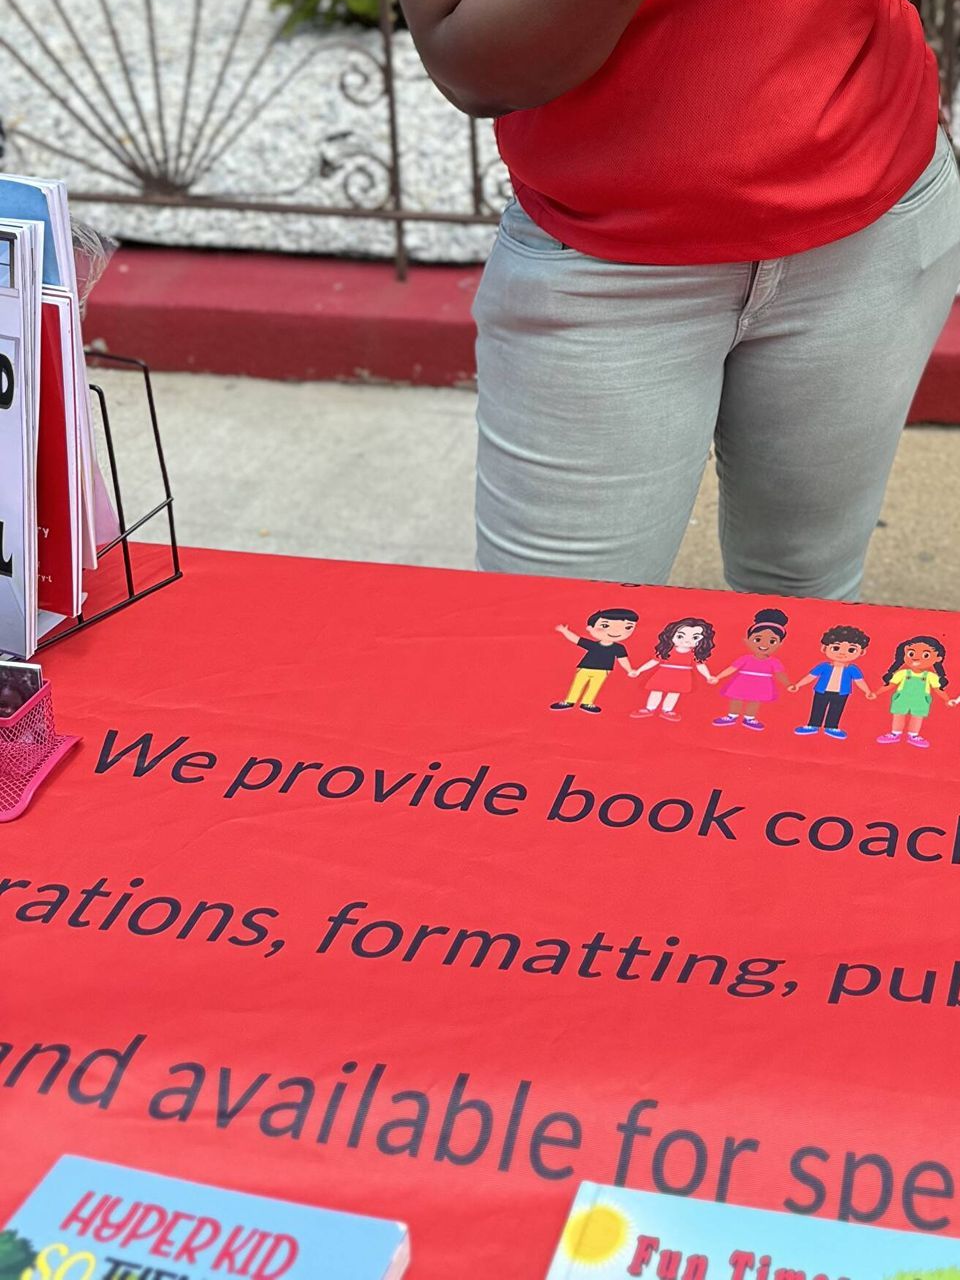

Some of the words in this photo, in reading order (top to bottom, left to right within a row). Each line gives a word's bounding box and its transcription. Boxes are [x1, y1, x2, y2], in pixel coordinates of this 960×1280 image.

[94, 729, 217, 784] We
[223, 761, 528, 816] provide
[546, 774, 745, 840] book
[316, 901, 799, 998] formatting,
[148, 1061, 583, 1181] available
[612, 1099, 760, 1204] for
[59, 1190, 222, 1266] HYPER
[210, 1224, 300, 1280] KID
